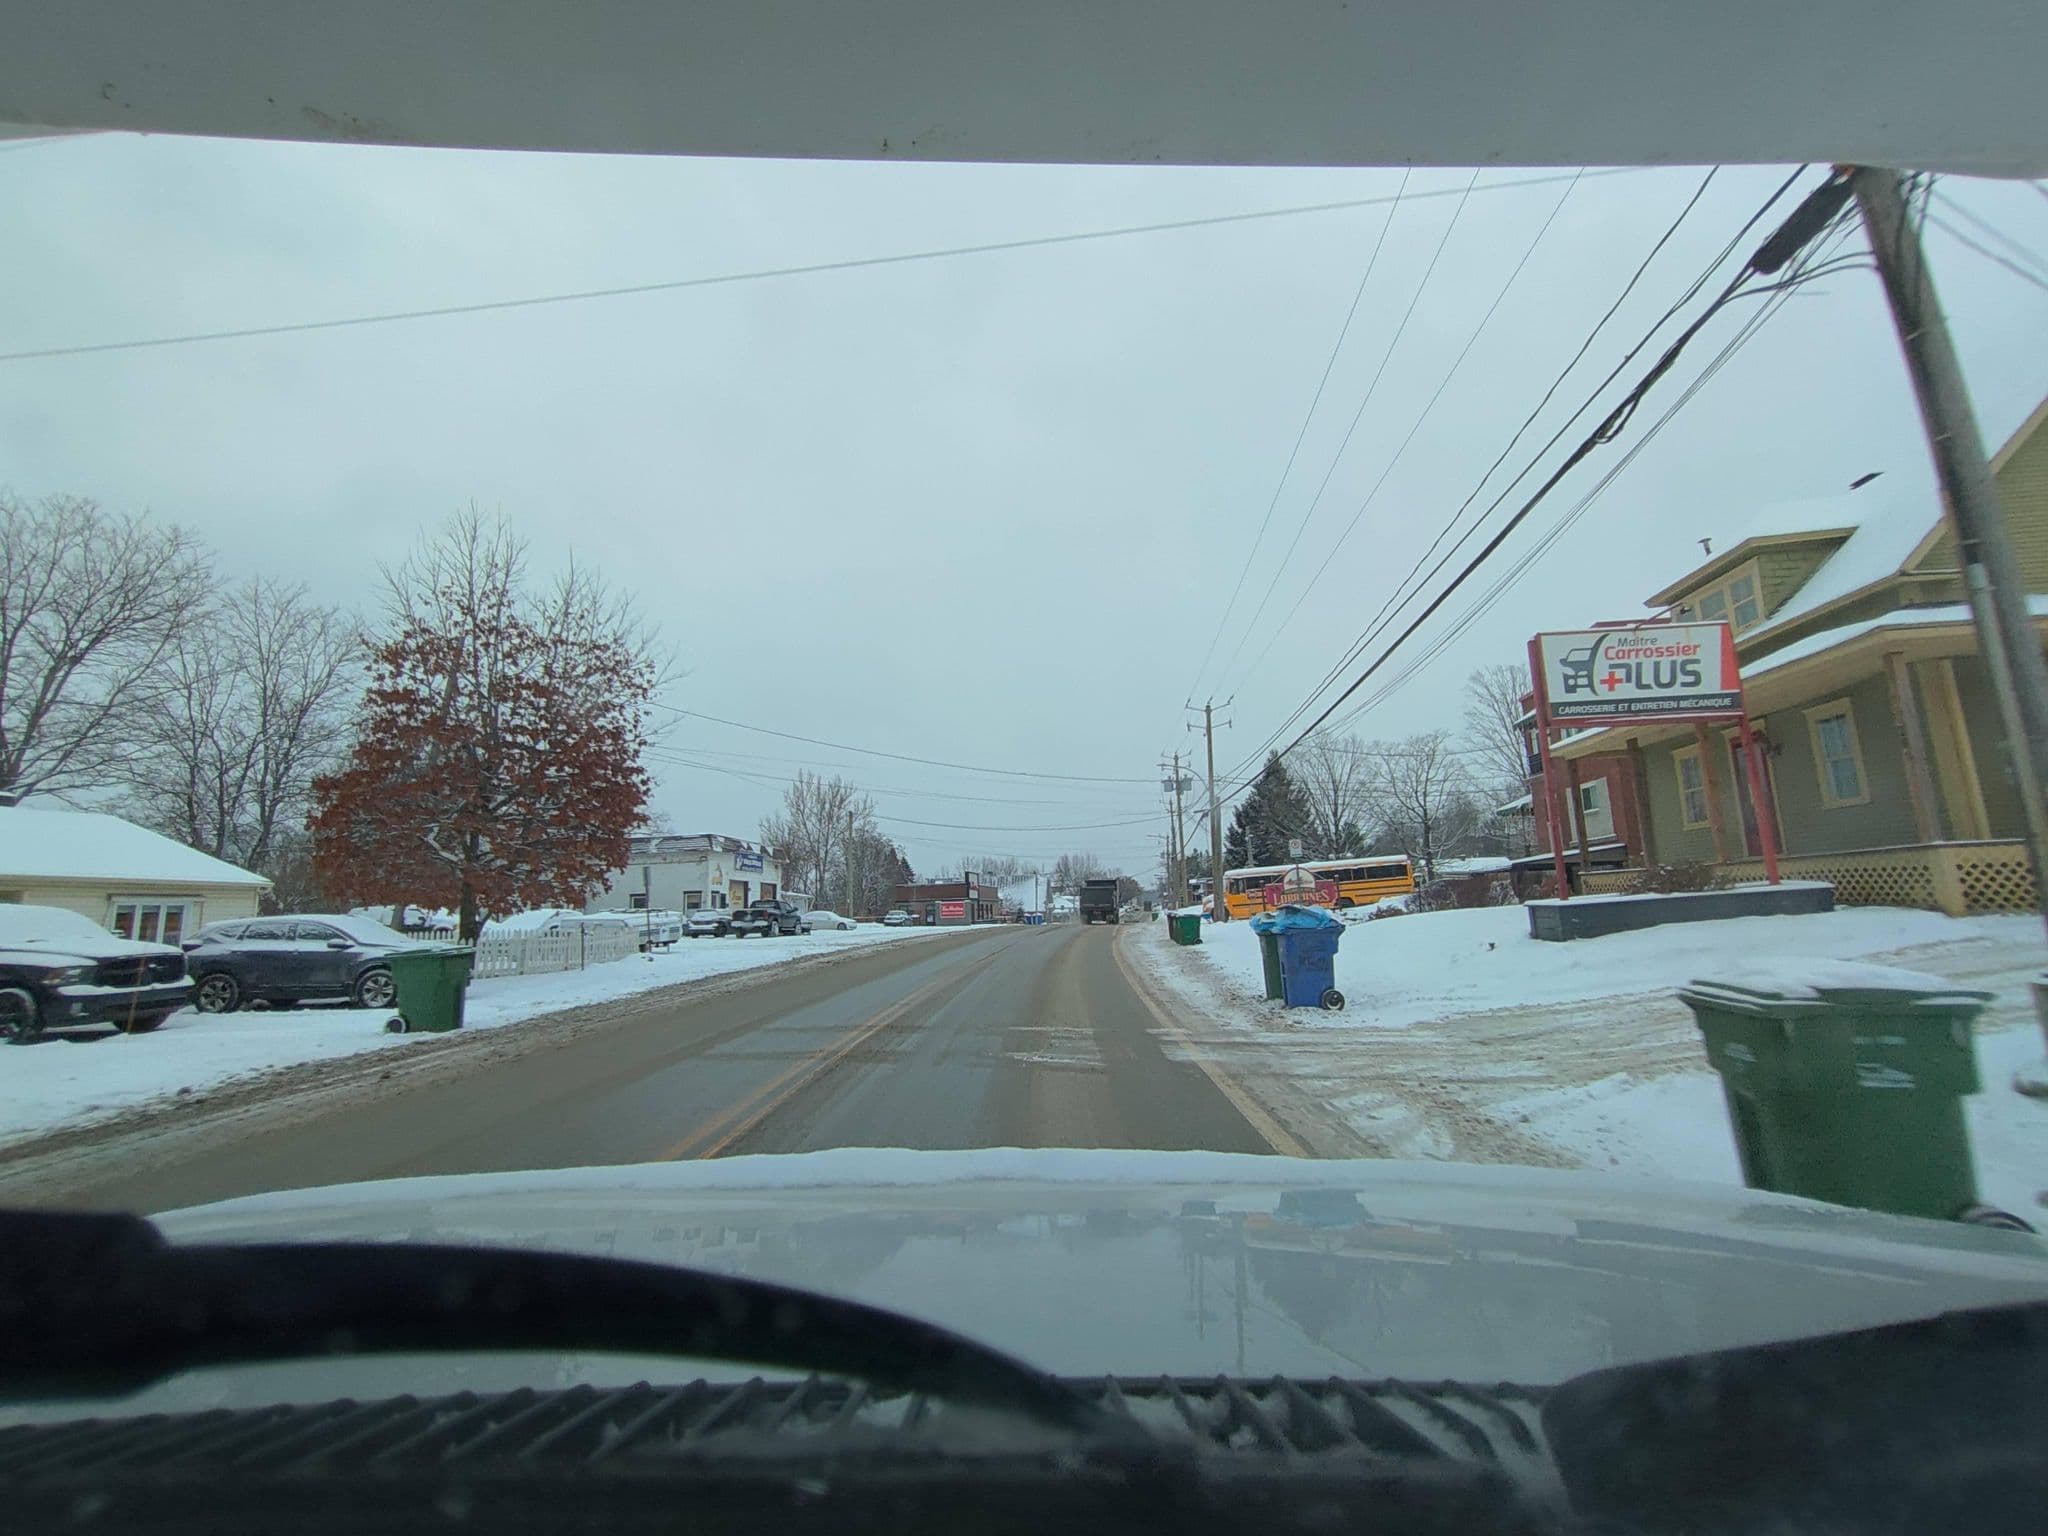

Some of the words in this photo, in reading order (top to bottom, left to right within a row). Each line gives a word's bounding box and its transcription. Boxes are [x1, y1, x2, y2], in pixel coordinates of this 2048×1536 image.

[1604, 642, 1701, 660] Carrossier
[1600, 658, 1702, 692] PLUS
[1558, 704, 1617, 714] CARROSSERIE
[1618, 703, 1629, 711] ET
[1631, 700, 1678, 711] ENTRETIEN
